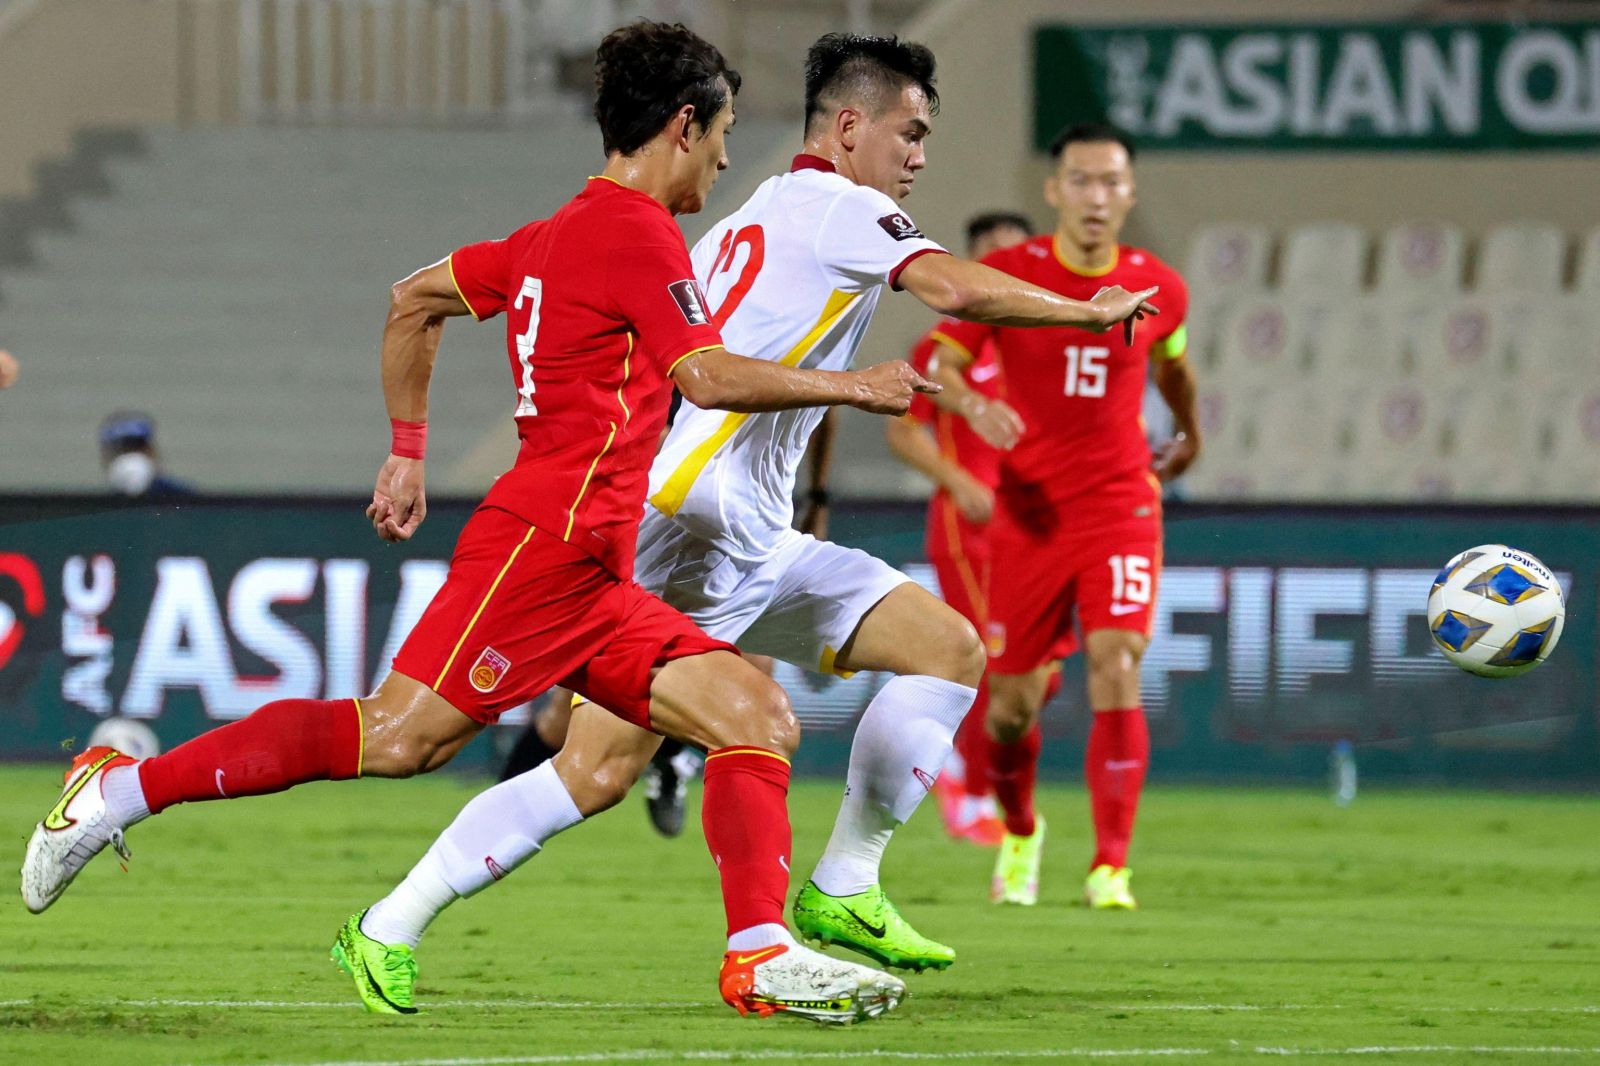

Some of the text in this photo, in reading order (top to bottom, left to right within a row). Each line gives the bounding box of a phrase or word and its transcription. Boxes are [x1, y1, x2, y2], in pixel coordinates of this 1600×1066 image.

[1153, 33, 1481, 136] ASIAN
[1064, 346, 1109, 397] 15
[1108, 554, 1151, 604] 15
[1502, 551, 1550, 581] molten
[62, 556, 116, 715] AFC
[121, 556, 450, 720] ASI
